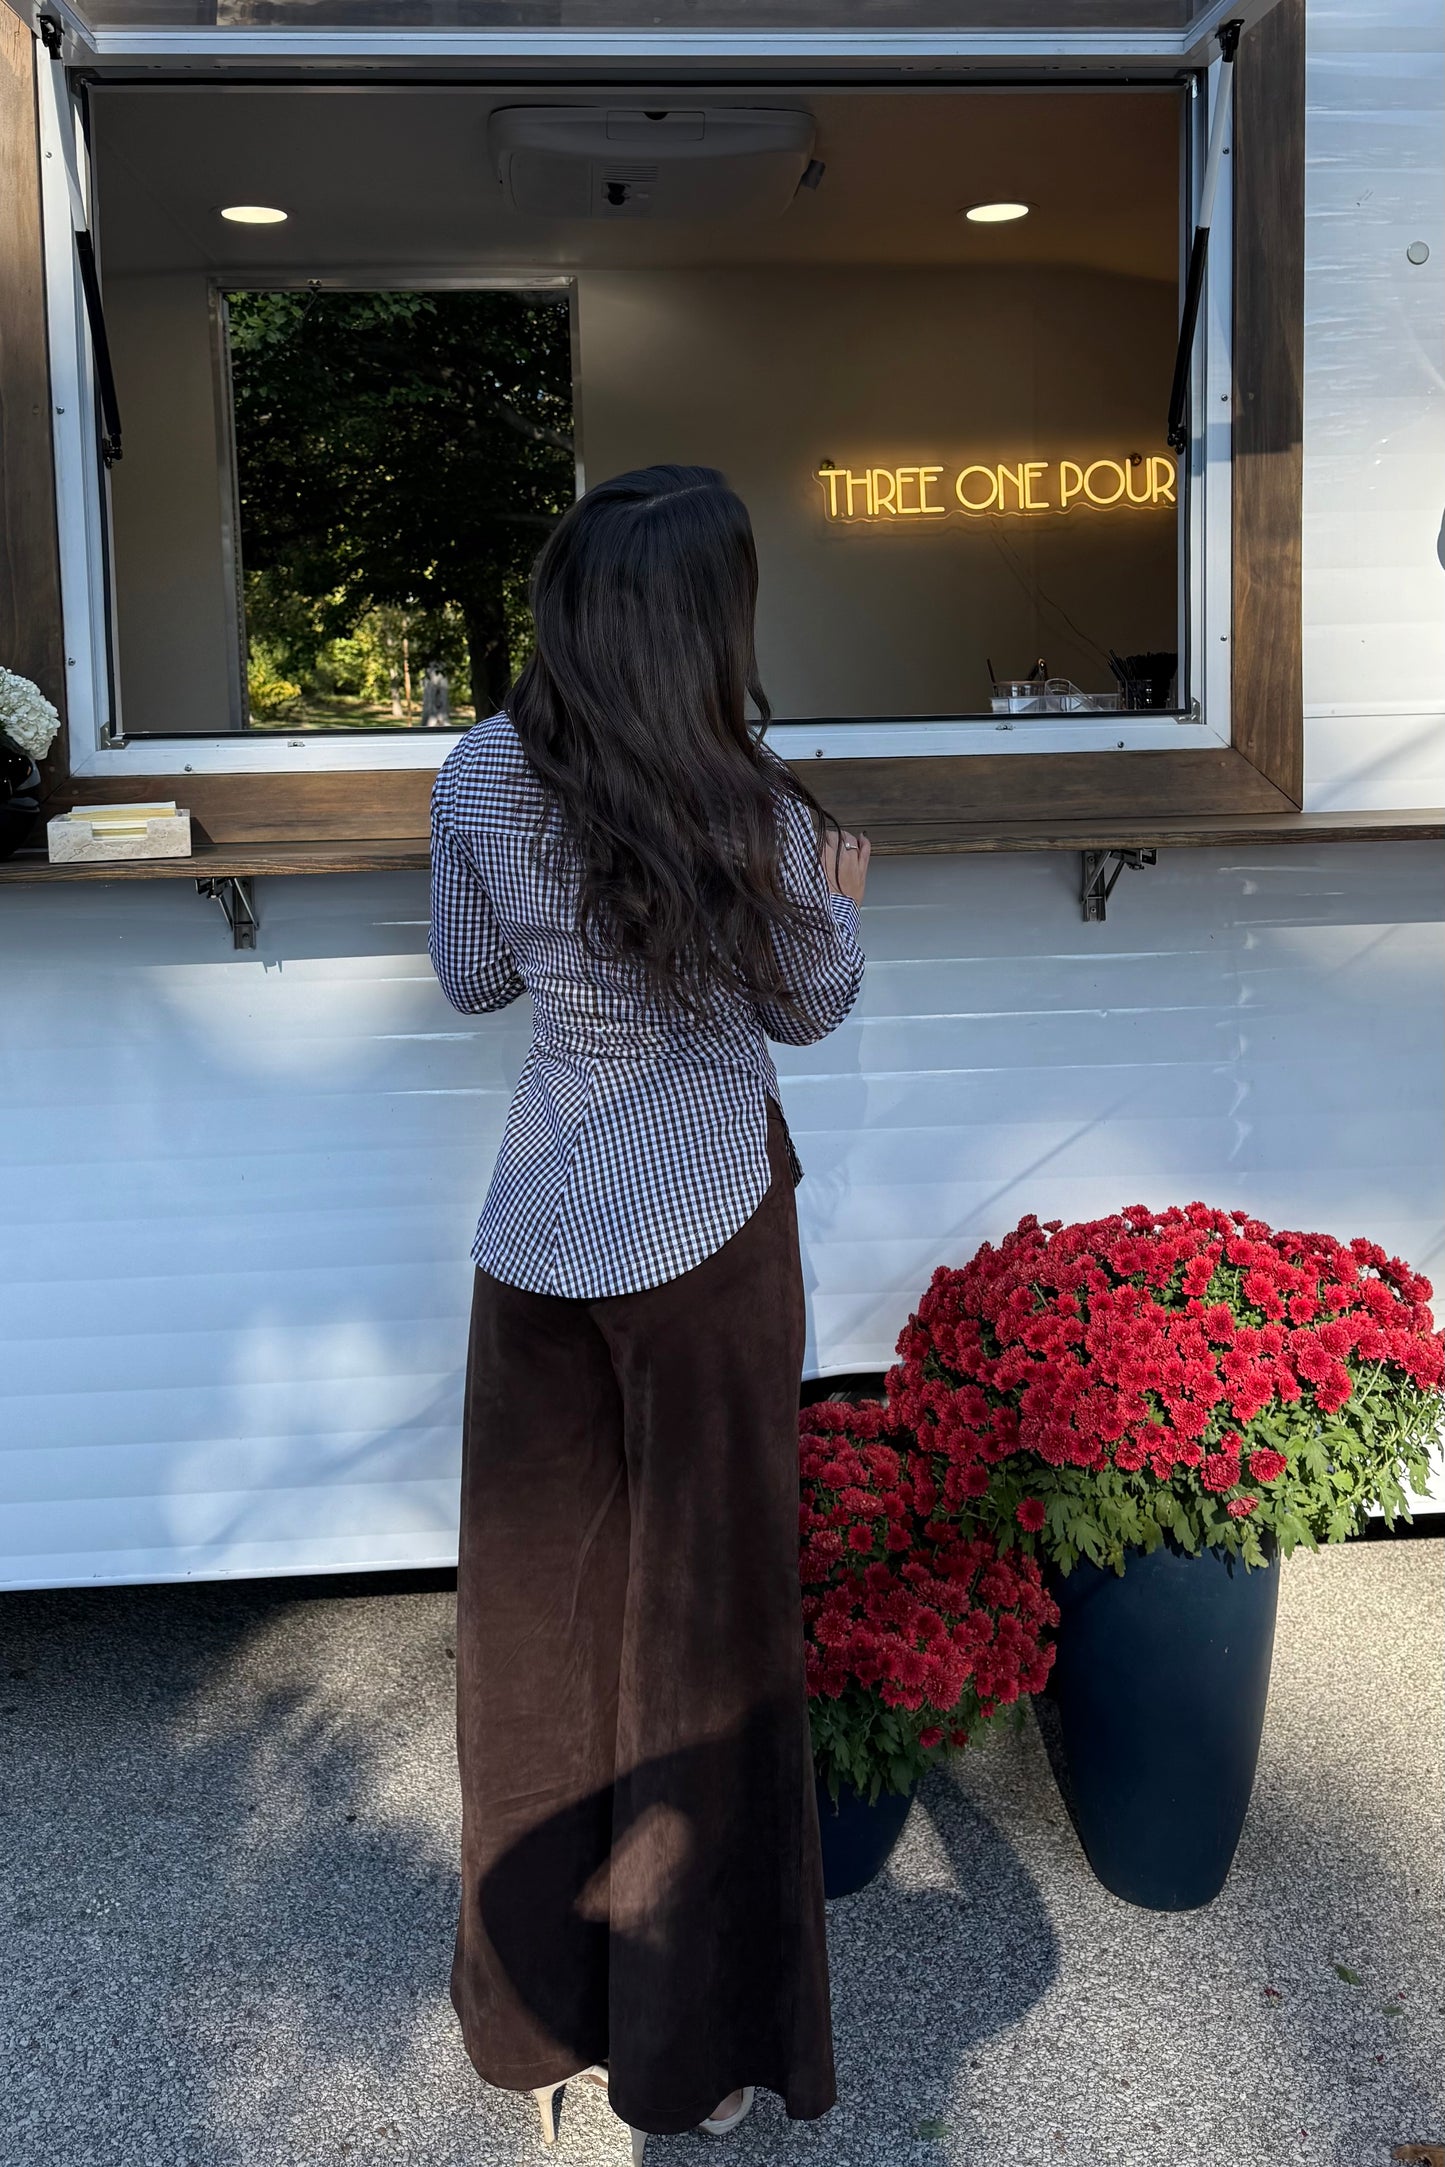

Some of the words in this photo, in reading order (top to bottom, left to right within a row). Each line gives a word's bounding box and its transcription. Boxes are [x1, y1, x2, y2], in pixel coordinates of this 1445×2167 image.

[818, 466, 945, 517] THREE
[955, 462, 1050, 511] ONE
[1060, 456, 1176, 508] POUR
